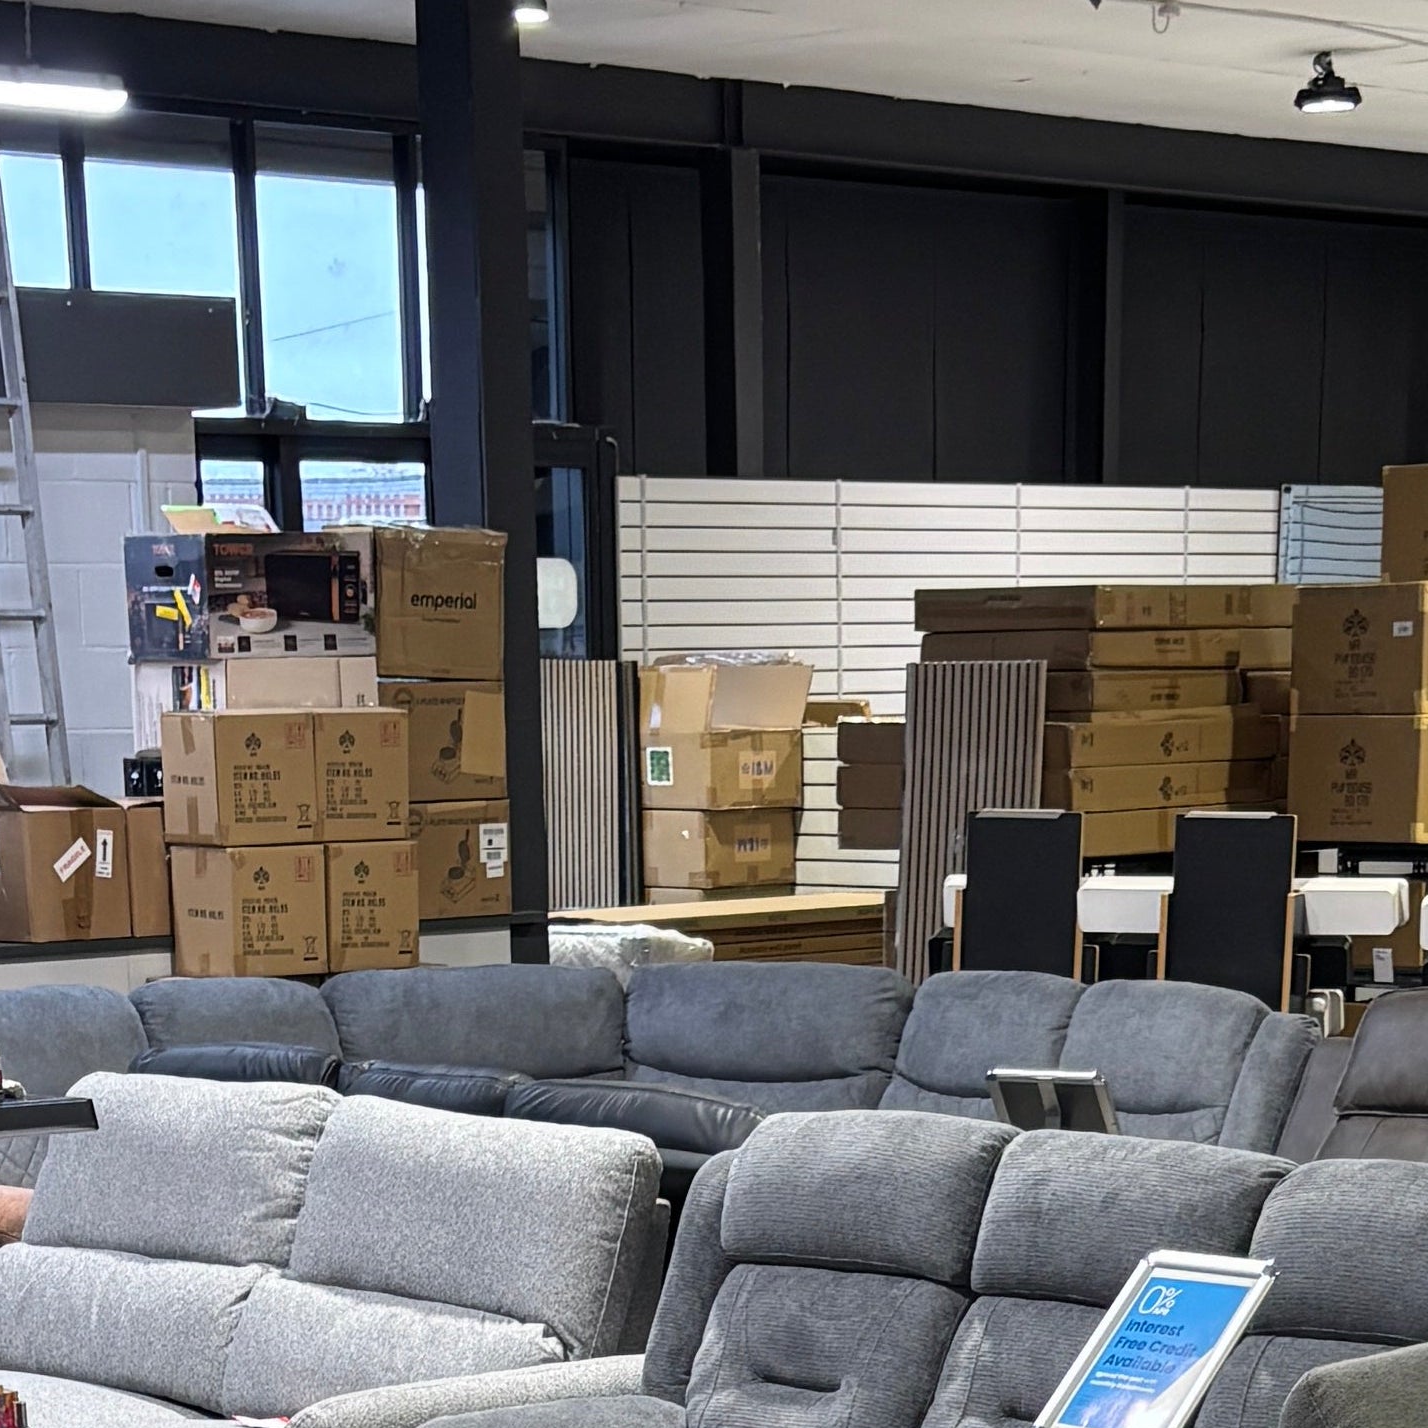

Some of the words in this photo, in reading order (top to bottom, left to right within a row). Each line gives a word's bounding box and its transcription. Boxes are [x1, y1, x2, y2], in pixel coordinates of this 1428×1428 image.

[410, 592, 477, 611] emperial
[1125, 1320, 1184, 1337] Interest
[1114, 1336, 1147, 1351] Free
[1149, 1341, 1197, 1357] Credit
